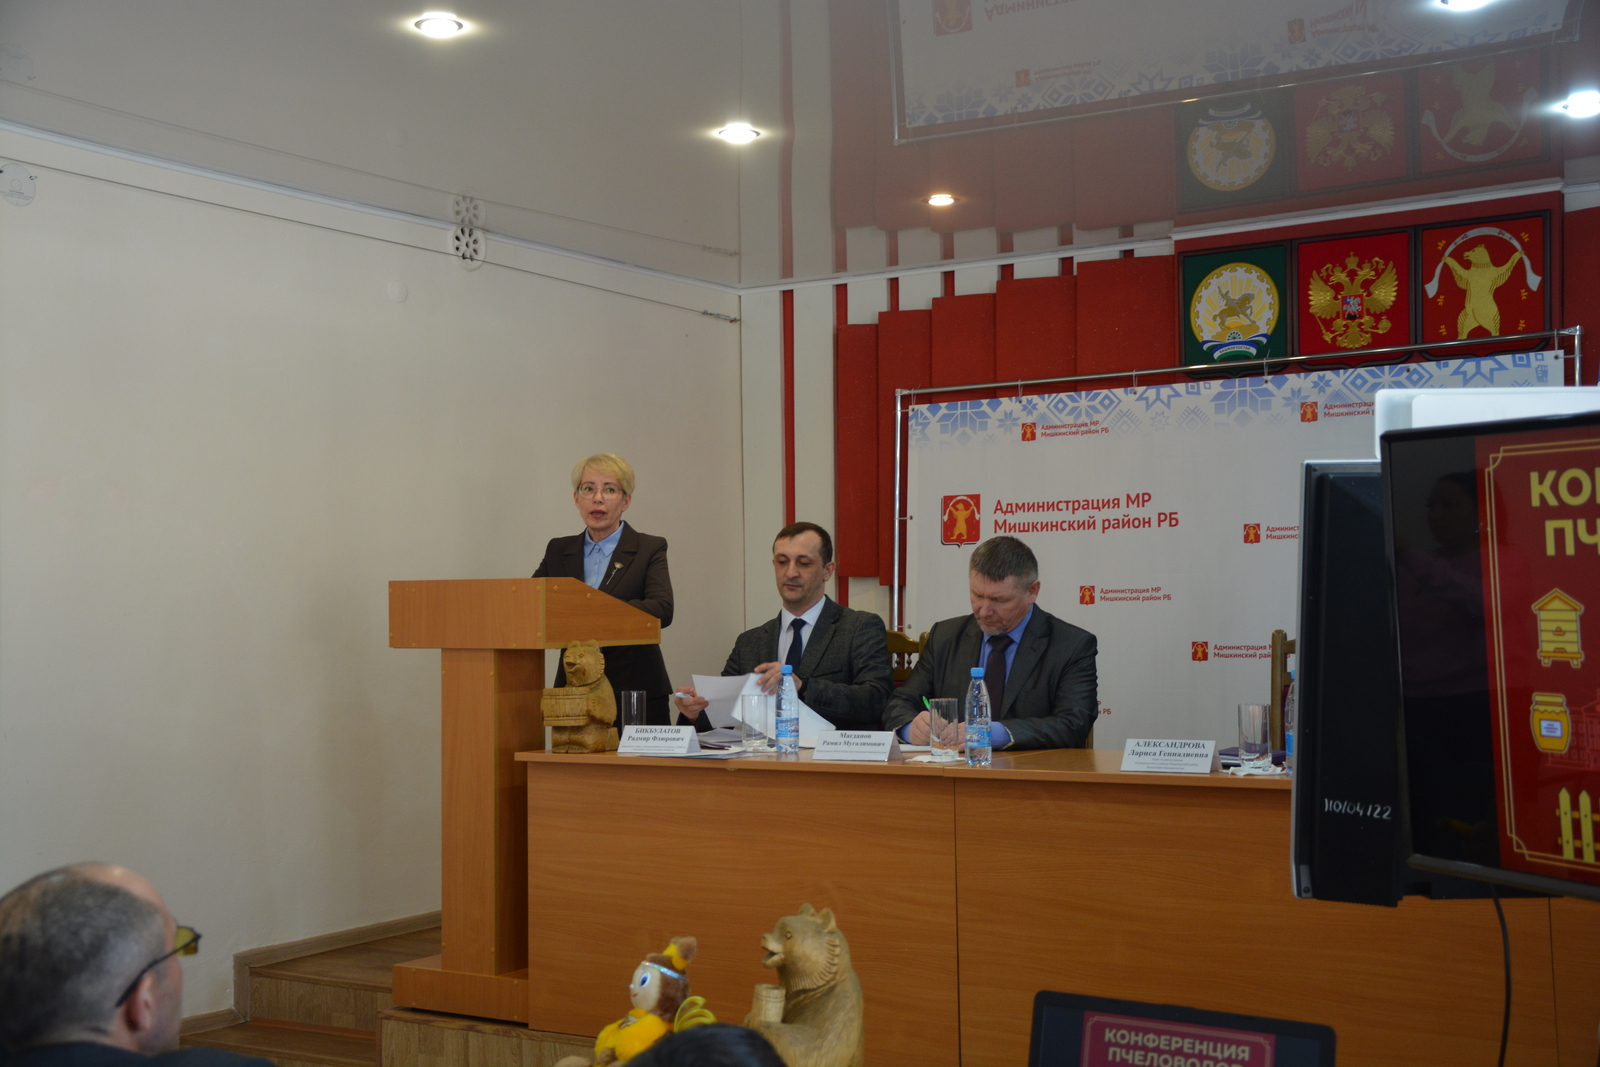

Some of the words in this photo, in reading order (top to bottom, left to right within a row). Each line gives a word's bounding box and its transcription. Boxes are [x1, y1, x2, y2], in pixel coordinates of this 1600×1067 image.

[1324, 409, 1370, 417] Мишкинский
[1041, 422, 1088, 430] Администрация
[1041, 429, 1079, 437] Мишкинский
[1081, 428, 1099, 436] район
[1530, 467, 1600, 507] КО
[993, 498, 1120, 515] Администрация
[1126, 492, 1152, 508] МР
[994, 515, 1096, 534] Мишкинский
[1102, 514, 1151, 534] район
[1158, 512, 1179, 528] РБ
[1259, 651, 1271, 660] рай
[1134, 741, 1206, 749] АЛЕКСАНДРОВА
[1128, 749, 1156, 757] Лариса
[1158, 750, 1208, 758] Геннадиевна
[1105, 1028, 1250, 1061] КОНФЕРЕНЦИЯ
